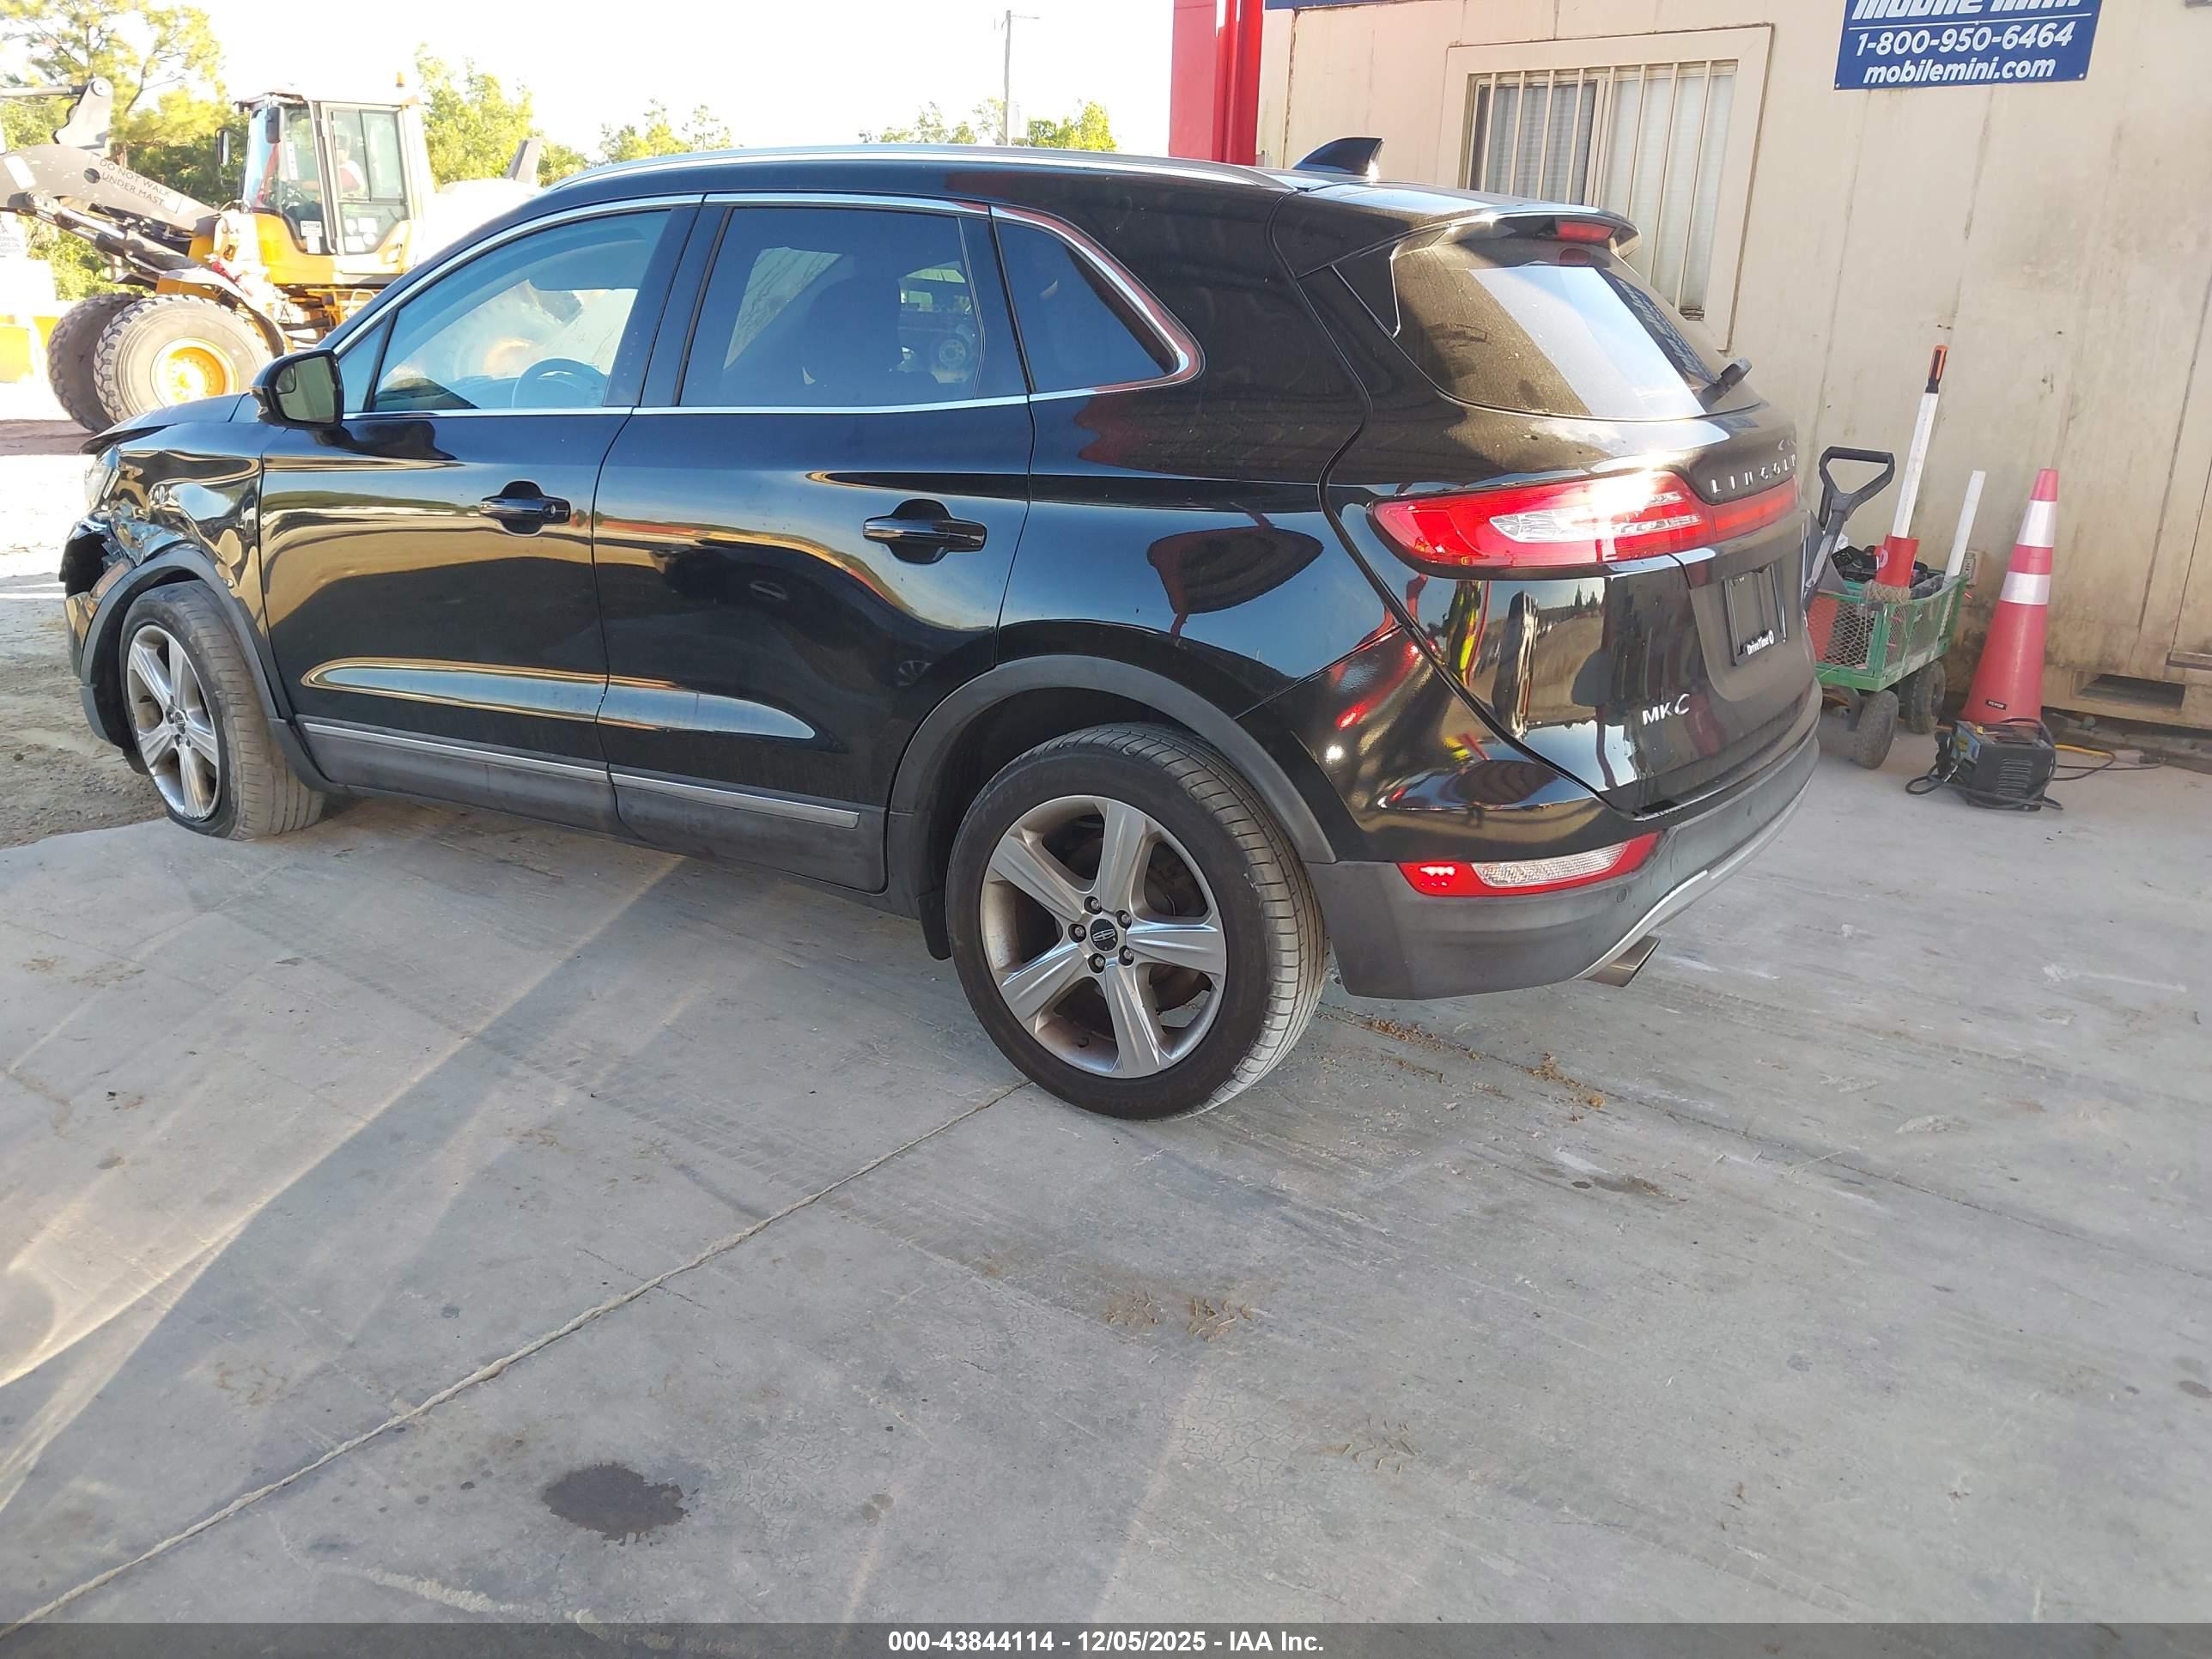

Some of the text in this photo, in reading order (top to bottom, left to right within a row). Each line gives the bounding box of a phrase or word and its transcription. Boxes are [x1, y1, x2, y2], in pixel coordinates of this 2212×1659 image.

[1856, 21, 2076, 56] 1-800-950-6464
[1862, 56, 2057, 84] mobilemini.com
[100, 158, 172, 197] DO NOT WALK
[101, 172, 165, 206] UNDER MAST
[1642, 693, 1691, 726] MKC
